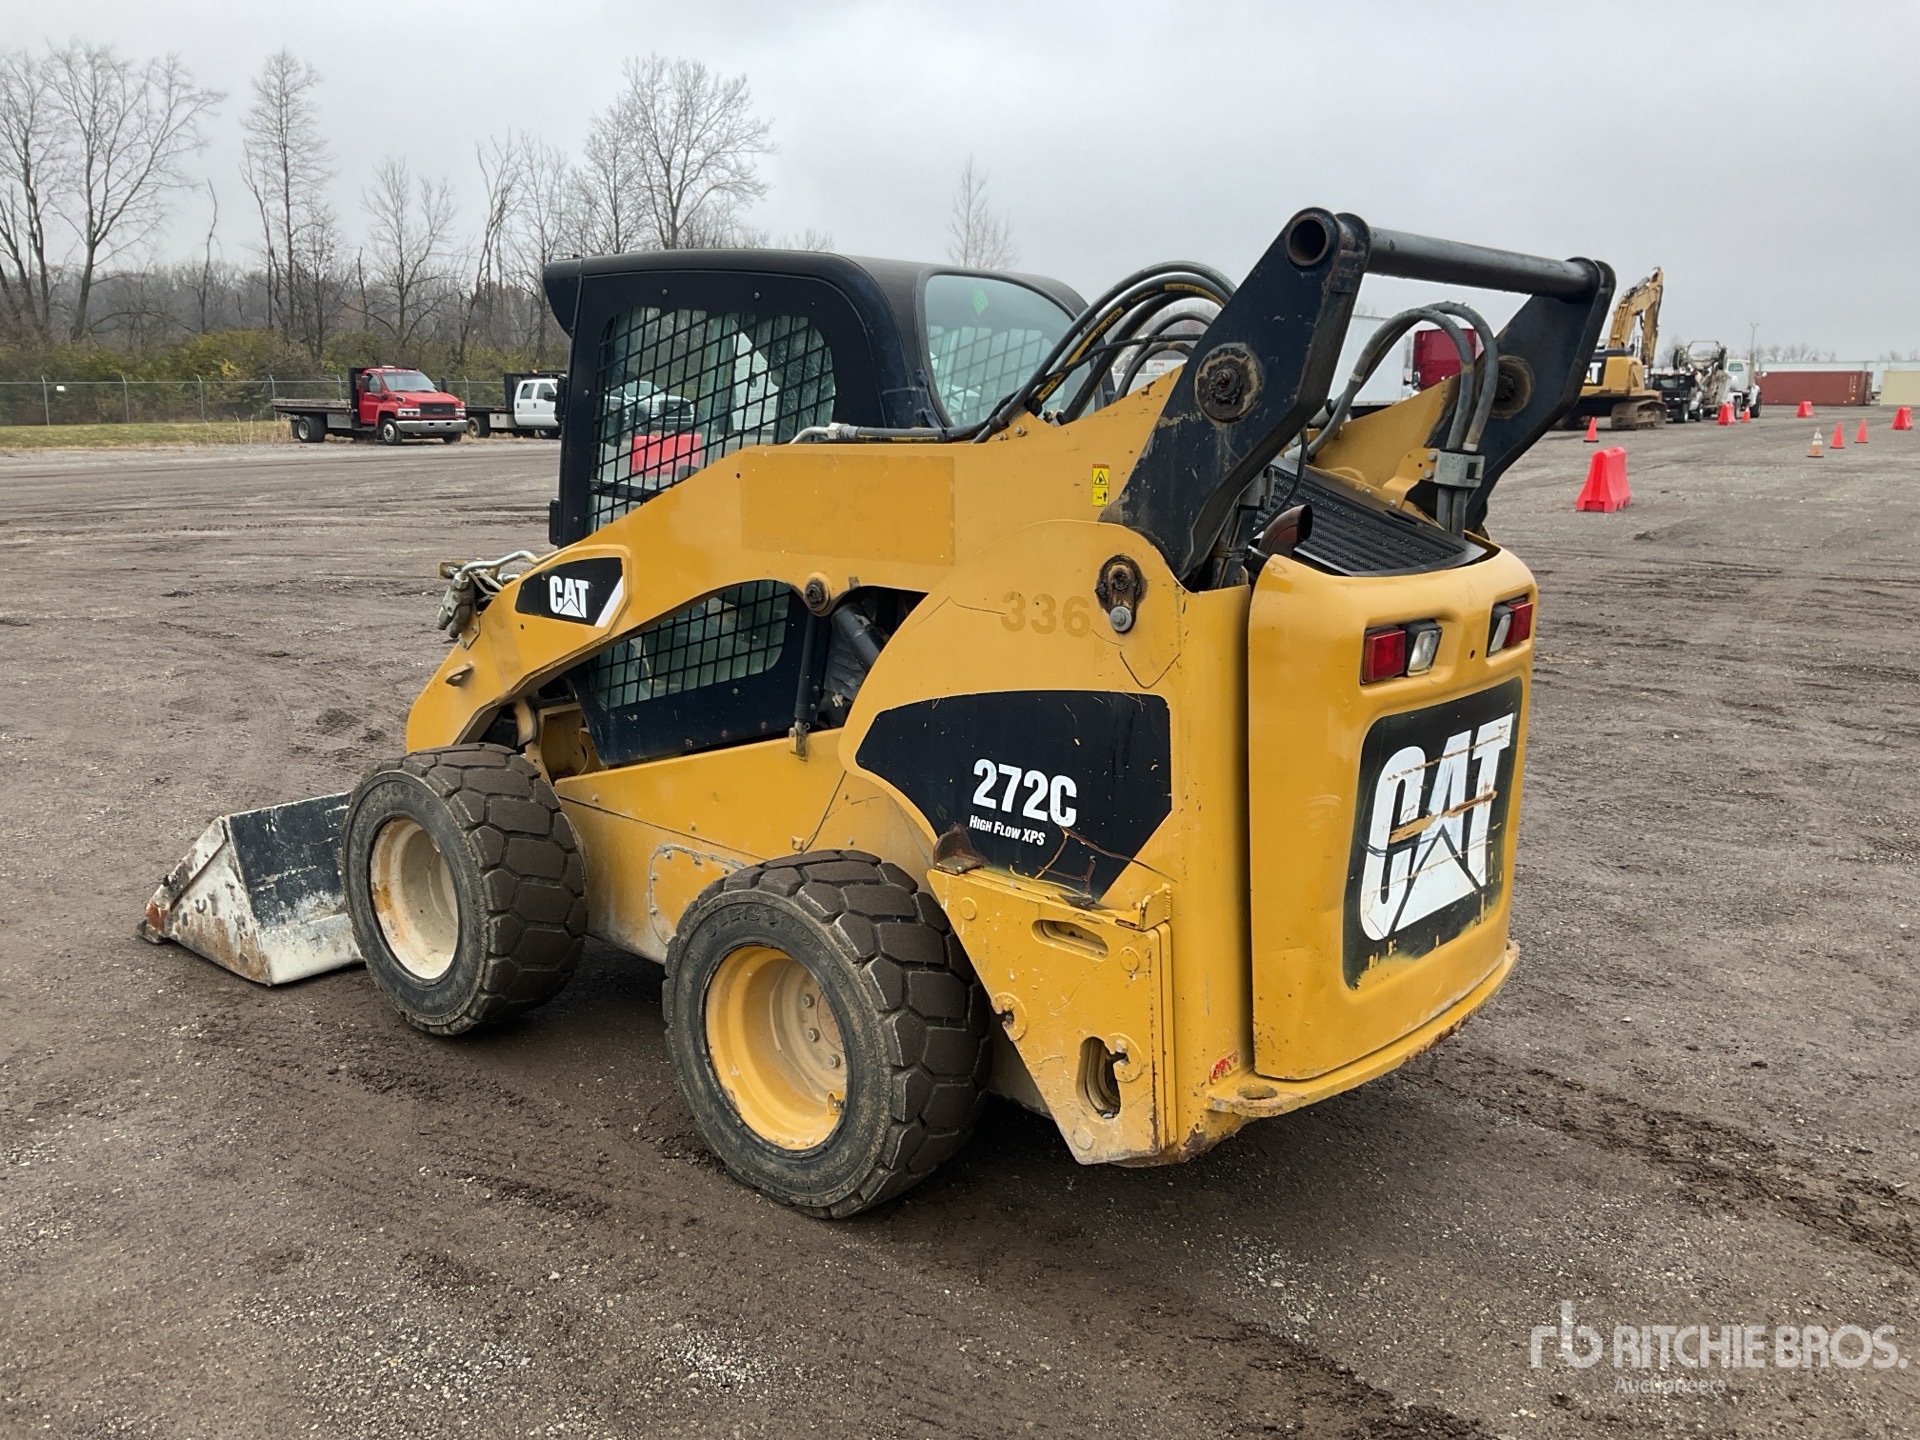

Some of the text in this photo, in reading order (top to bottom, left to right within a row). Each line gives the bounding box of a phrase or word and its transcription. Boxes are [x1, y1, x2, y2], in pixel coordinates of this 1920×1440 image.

[549, 575, 589, 618] CAT
[1001, 591, 1090, 637] 336
[973, 759, 1077, 827] 272C
[969, 815, 1046, 846] HIGH FLOW XPS
[1360, 713, 1514, 940] CAT
